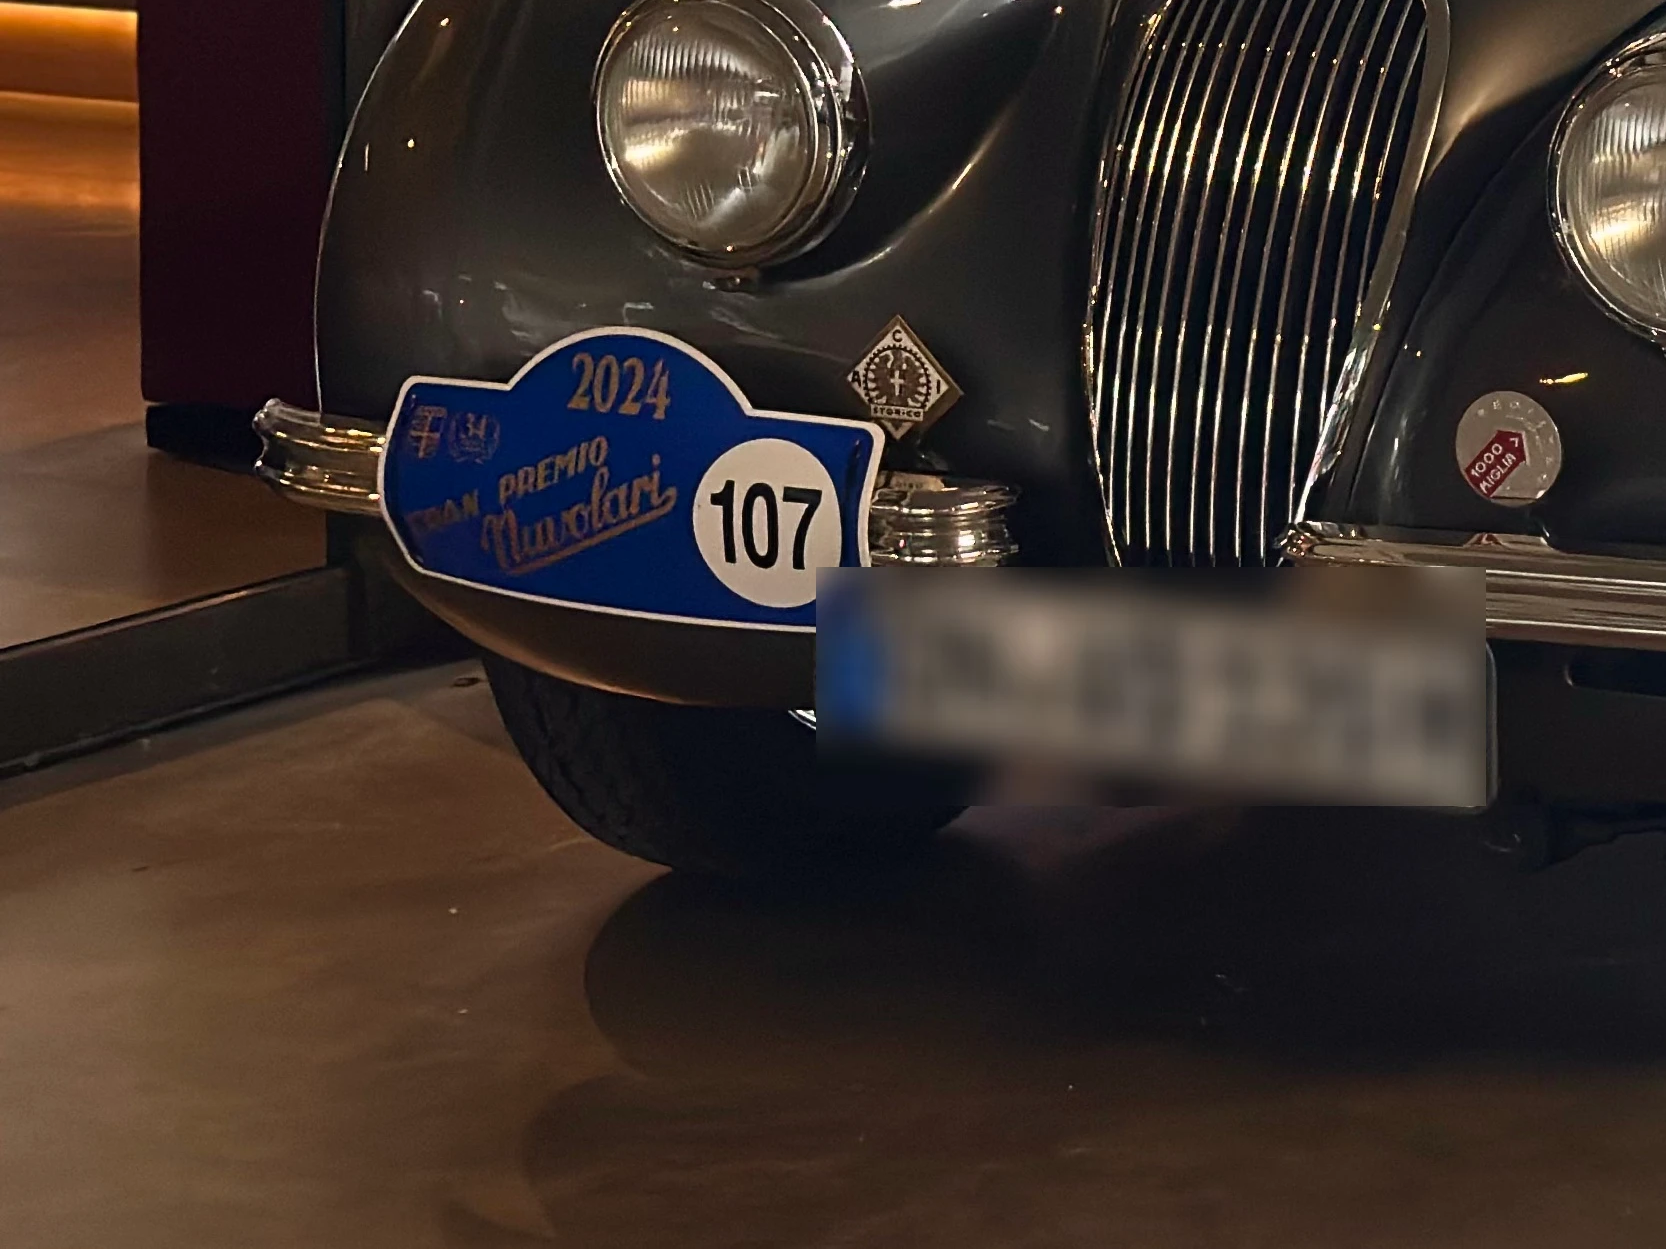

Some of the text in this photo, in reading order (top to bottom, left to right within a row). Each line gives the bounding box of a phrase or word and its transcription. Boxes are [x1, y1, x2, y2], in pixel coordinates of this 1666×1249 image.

[567, 352, 670, 420] 2024
[499, 435, 609, 508] PREMIO
[1470, 443, 1503, 477] 1000
[1479, 453, 1517, 494] MIGLIA
[481, 453, 678, 573] Nuvolari
[710, 479, 822, 570] 107
